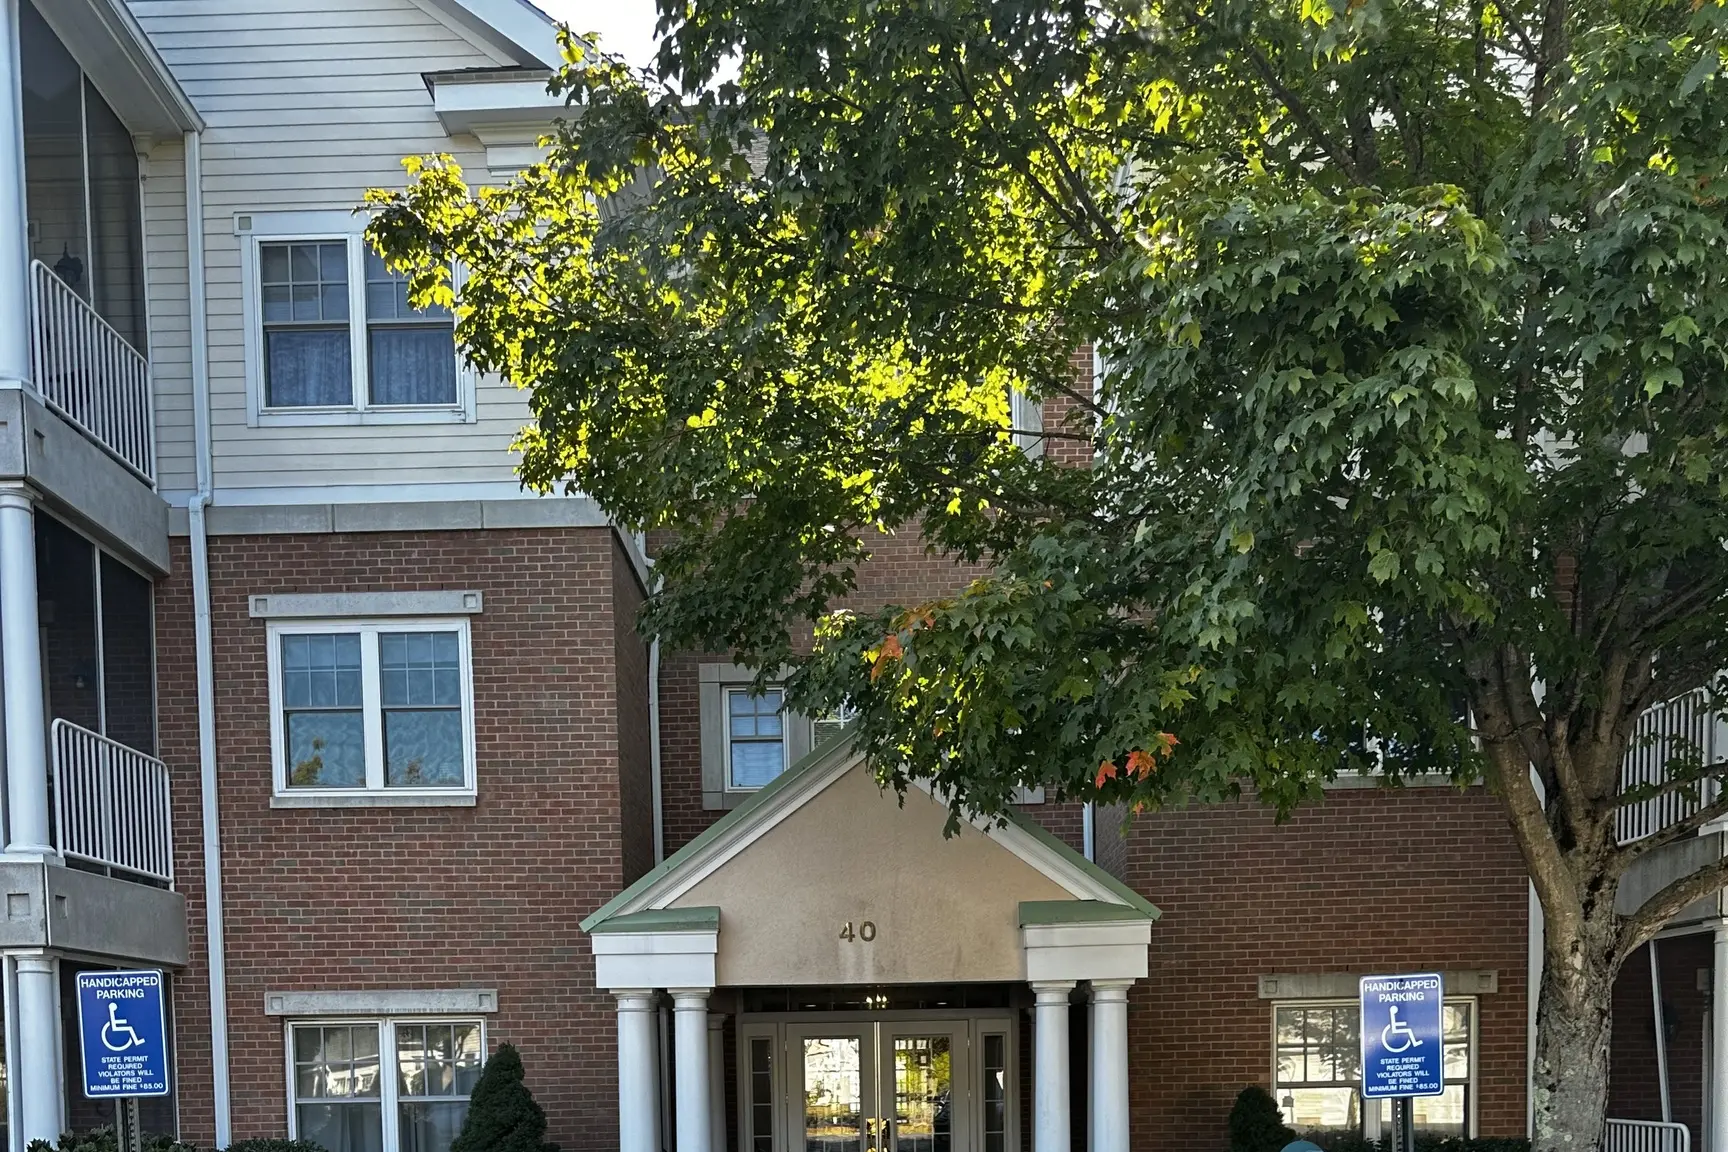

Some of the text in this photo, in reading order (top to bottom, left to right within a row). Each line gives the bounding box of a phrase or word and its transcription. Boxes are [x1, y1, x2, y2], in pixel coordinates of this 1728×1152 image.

[839, 921, 876, 943] 40
[80, 976, 158, 988] HANDICAPPED
[1364, 980, 1438, 992] HANDICAPPED
[96, 989, 145, 999] PARKING
[1379, 992, 1425, 1002] PARKING
[101, 1055, 148, 1064] STATE PERMIT
[1380, 1056, 1426, 1065] STATE PERMIT
[1386, 1063, 1420, 1071] REQUIRED
[122, 1083, 138, 1091] FINE
[1399, 1083, 1414, 1091] FINE
